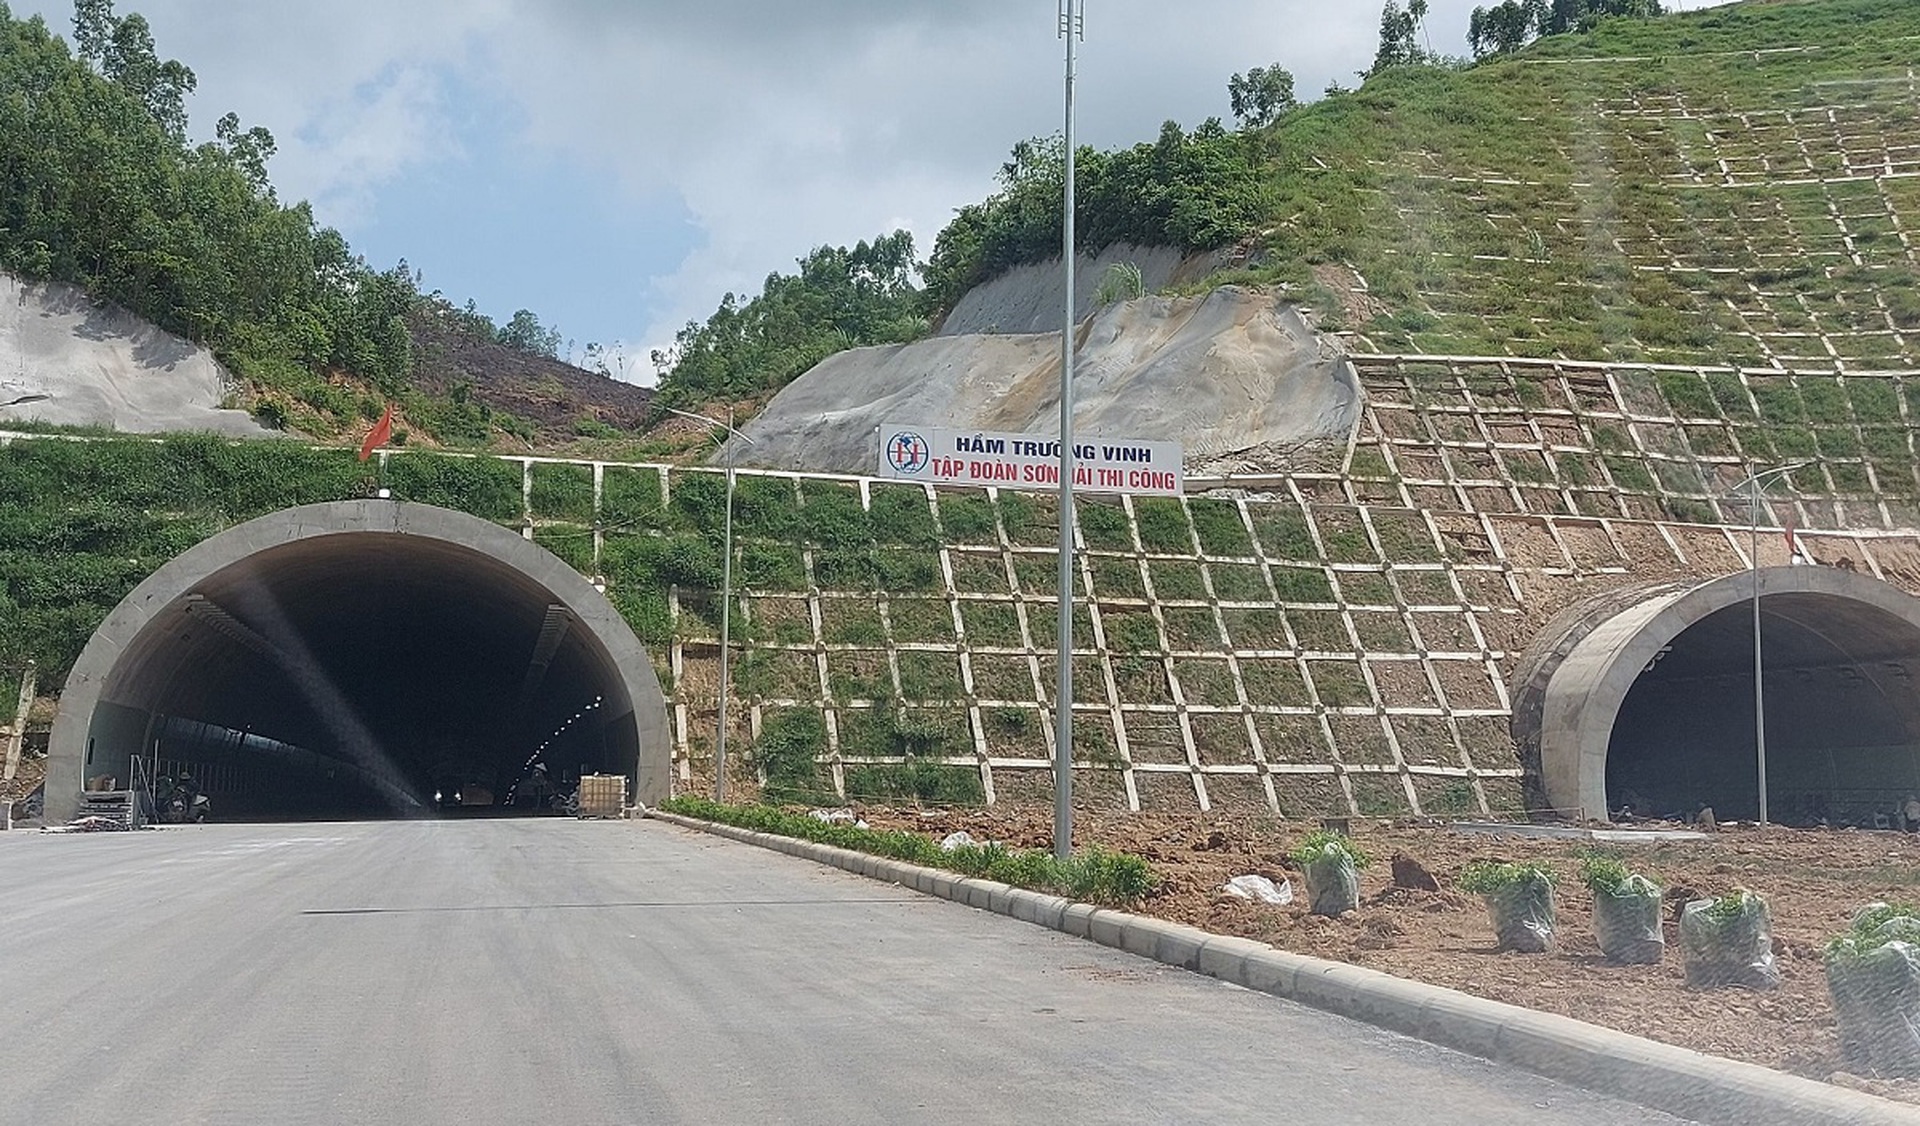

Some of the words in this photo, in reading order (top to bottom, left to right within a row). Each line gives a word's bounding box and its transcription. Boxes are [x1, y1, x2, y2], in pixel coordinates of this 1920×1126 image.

[956, 433, 1004, 454] HẦM
[1102, 446, 1151, 463] VINH
[932, 455, 964, 480] TẬP
[970, 459, 1017, 481] ĐOÀN
[1024, 464, 1058, 484] SƠN
[1098, 469, 1123, 487] THI
[1129, 468, 1175, 490] CÔNG
